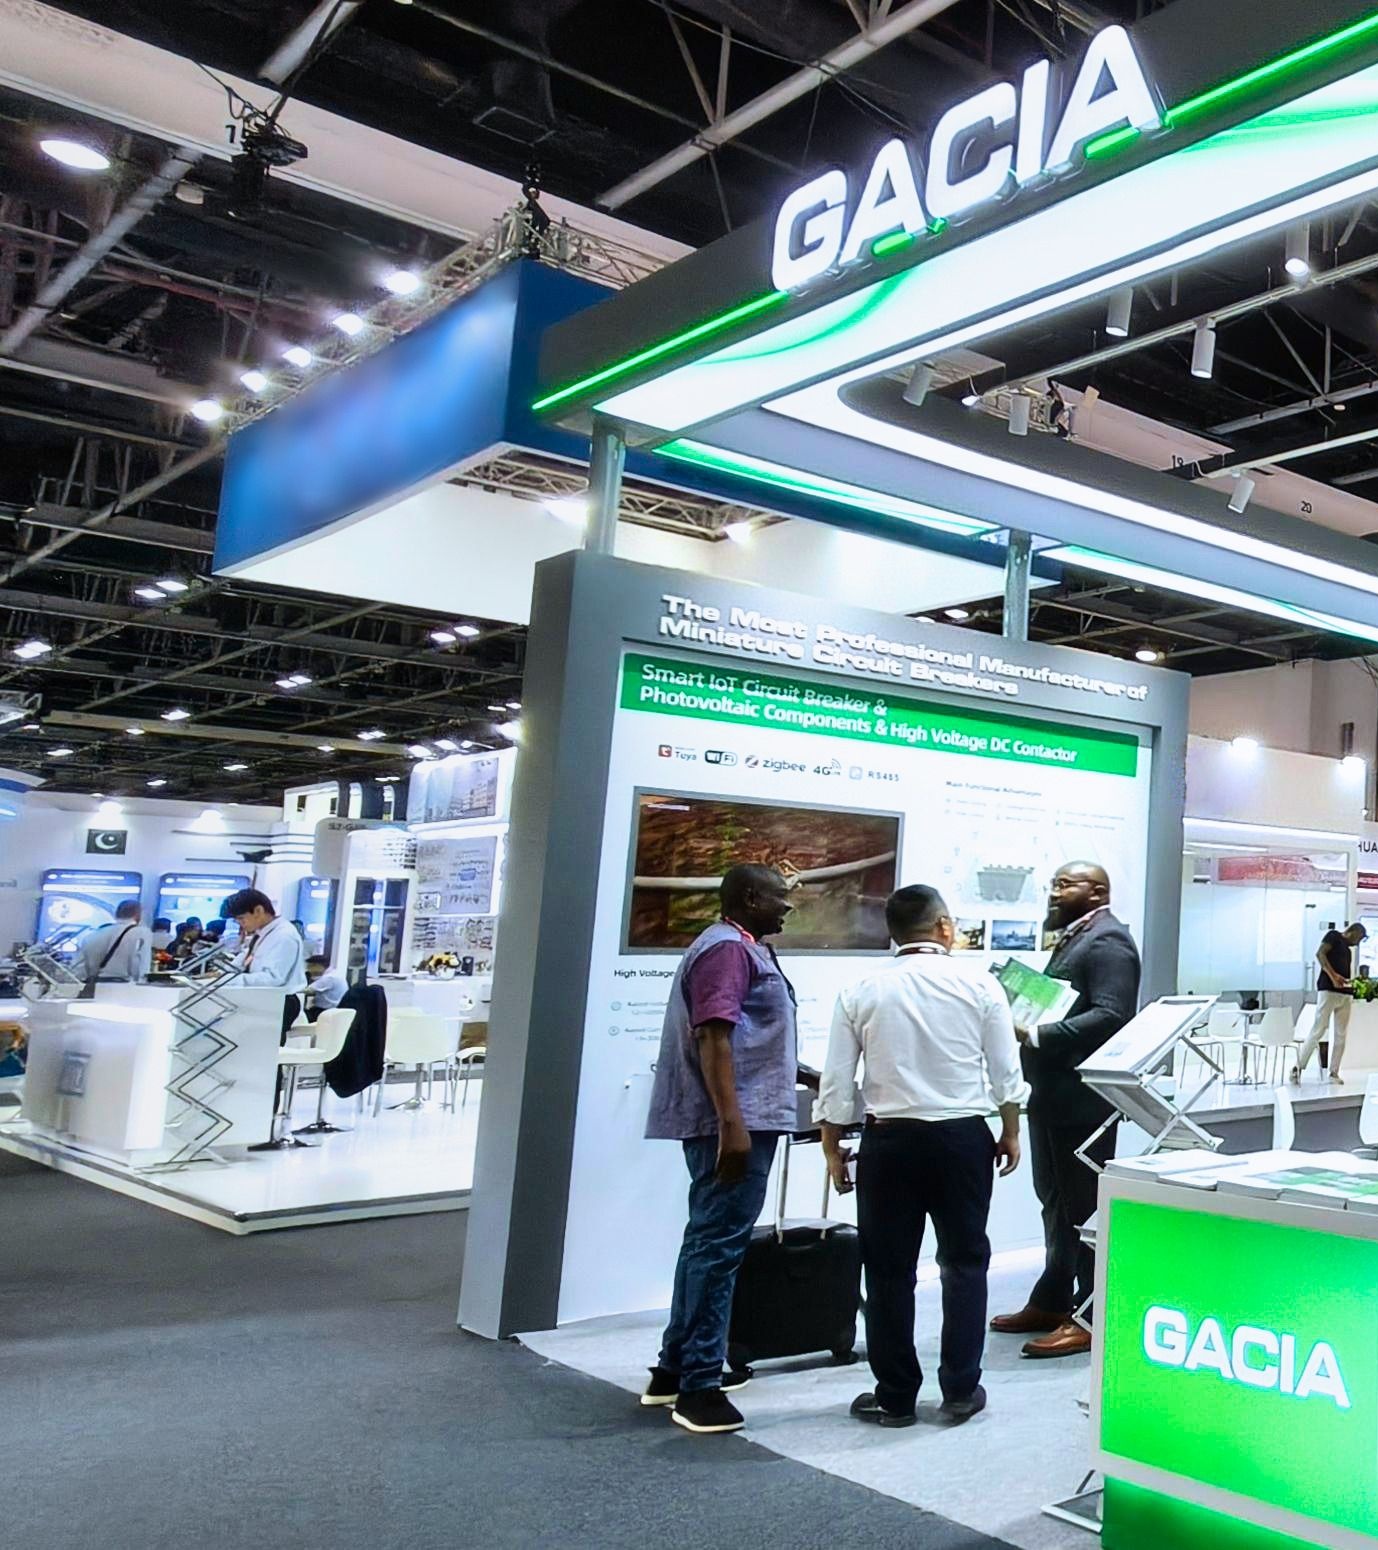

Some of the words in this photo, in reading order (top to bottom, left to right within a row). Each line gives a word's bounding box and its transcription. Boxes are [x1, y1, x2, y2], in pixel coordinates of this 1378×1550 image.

[772, 24, 1162, 291] GACIA
[659, 616, 804, 660] Miniature
[812, 643, 903, 676] Circuit
[909, 662, 1019, 696] Breakers
[661, 594, 721, 622] The
[729, 607, 808, 640] Most
[815, 622, 973, 671] Professional
[979, 655, 1126, 697] Manufacturer
[1126, 685, 1148, 701] of
[640, 685, 760, 718] Photovoltaic
[763, 703, 871, 734] Components
[874, 718, 888, 737] &
[890, 721, 927, 744] High
[930, 727, 987, 752] Voltage
[990, 736, 1011, 753] DC
[1013, 740, 1078, 763] Contactor
[641, 663, 705, 688] Smart
[708, 673, 738, 693] IoT
[742, 679, 800, 703] Circuit
[803, 688, 871, 712] Breaker
[873, 698, 888, 716] &
[762, 758, 806, 772] zigbee
[614, 969, 637, 979] High
[639, 969, 675, 979] Voltage
[1142, 1304, 1352, 1409] GACIA
